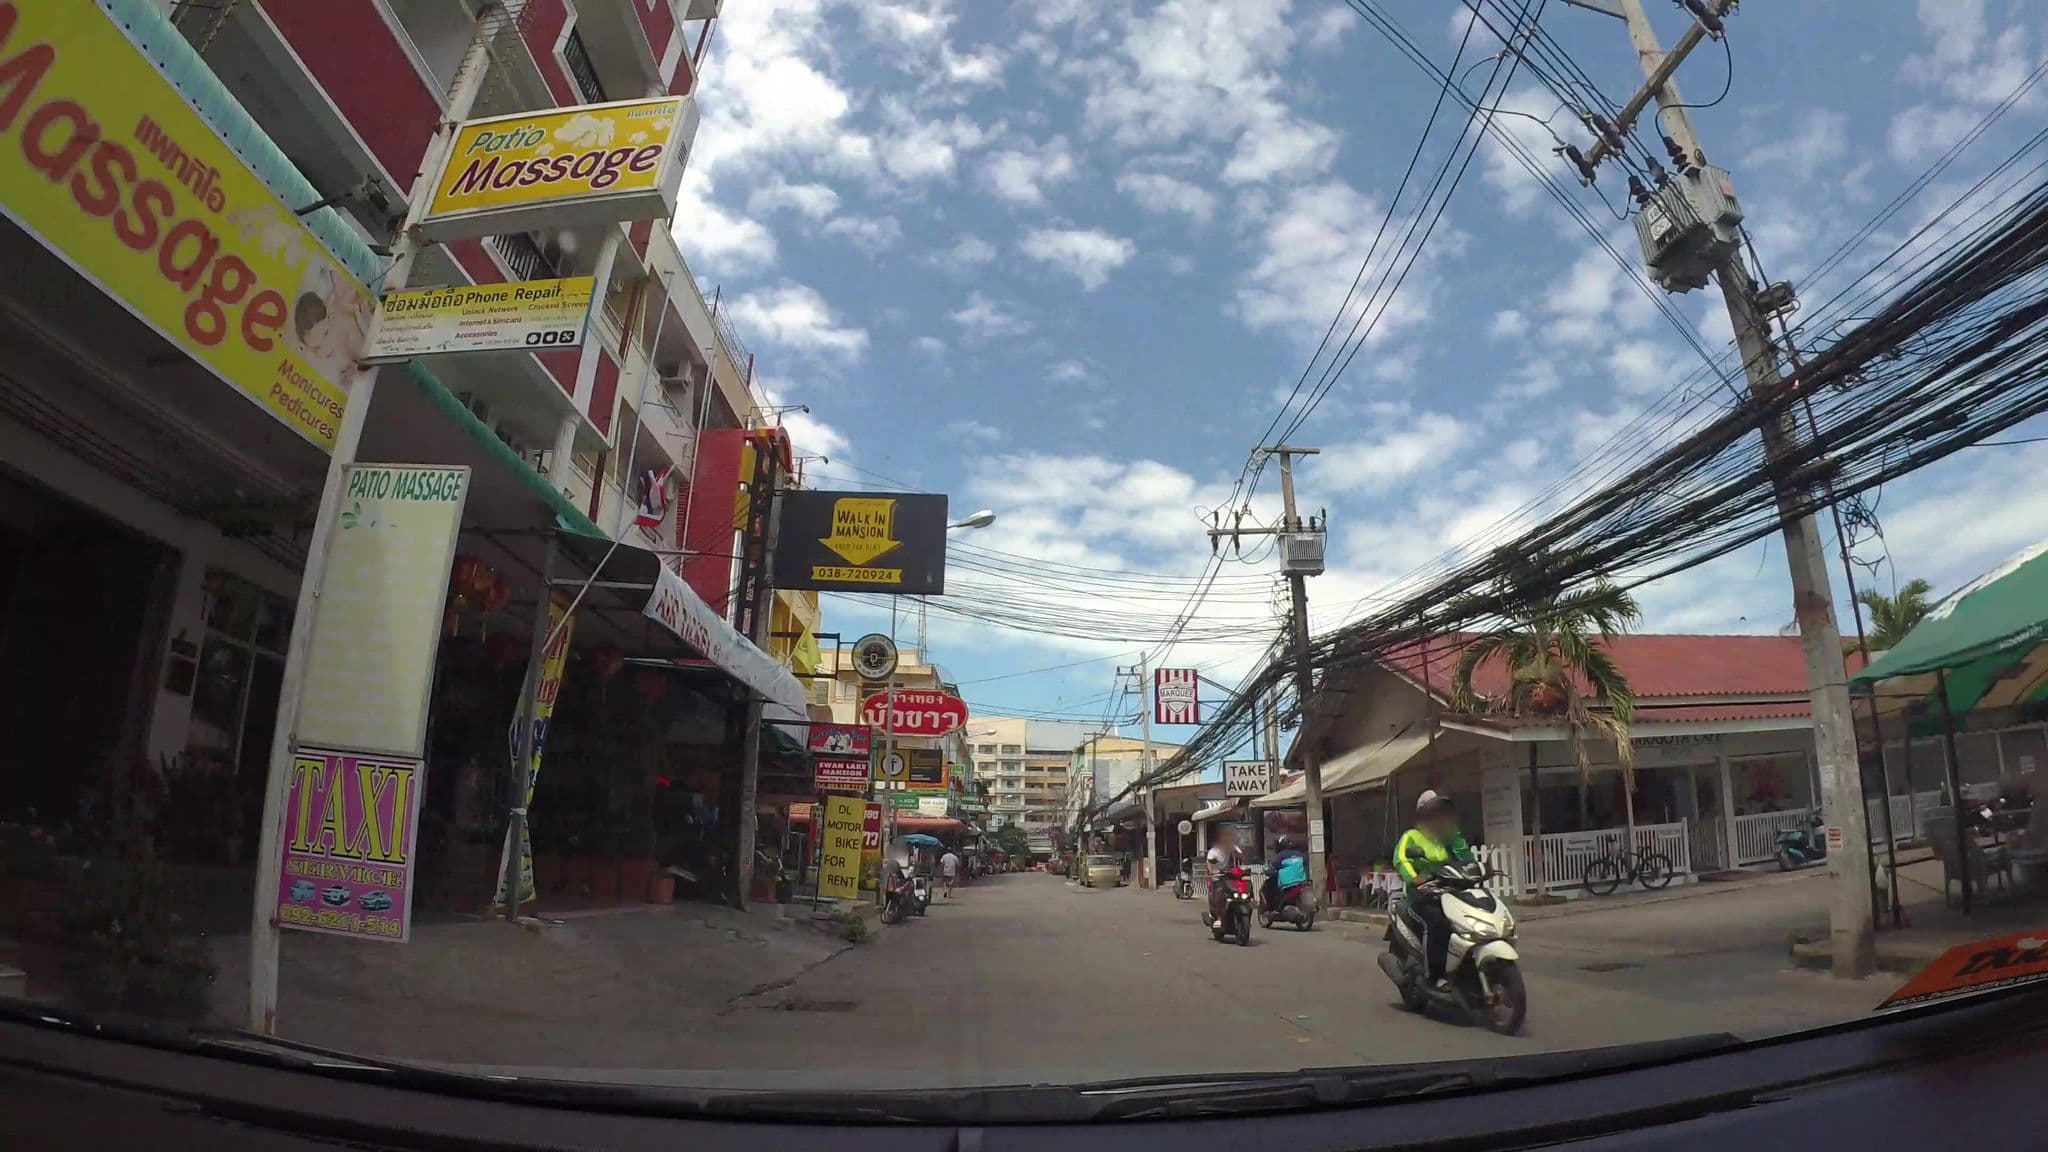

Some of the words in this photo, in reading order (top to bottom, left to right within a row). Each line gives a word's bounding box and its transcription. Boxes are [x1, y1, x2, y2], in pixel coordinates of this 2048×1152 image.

[466, 124, 546, 156] Patio
[448, 144, 665, 197] Massage
[465, 291, 508, 304] Phone
[514, 285, 562, 301] Repair
[278, 358, 345, 419] Manicures
[270, 382, 334, 440] Pedicures
[347, 470, 391, 499] PATIO
[391, 471, 463, 501] MASSAGE
[837, 510, 870, 525] WALK
[874, 510, 886, 525] IN
[835, 525, 884, 539] MANSION
[818, 568, 892, 580] 038-720924
[1160, 687, 1194, 698] MARQUEE
[1230, 764, 1266, 776] TAKE
[1228, 779, 1267, 792] AWAY
[290, 758, 414, 864] TAXI
[827, 820, 861, 833] MOTOR
[835, 837, 859, 849] BIKE
[824, 854, 846, 867] FOR
[288, 857, 404, 888] SERVICE
[827, 874, 856, 888] RENT
